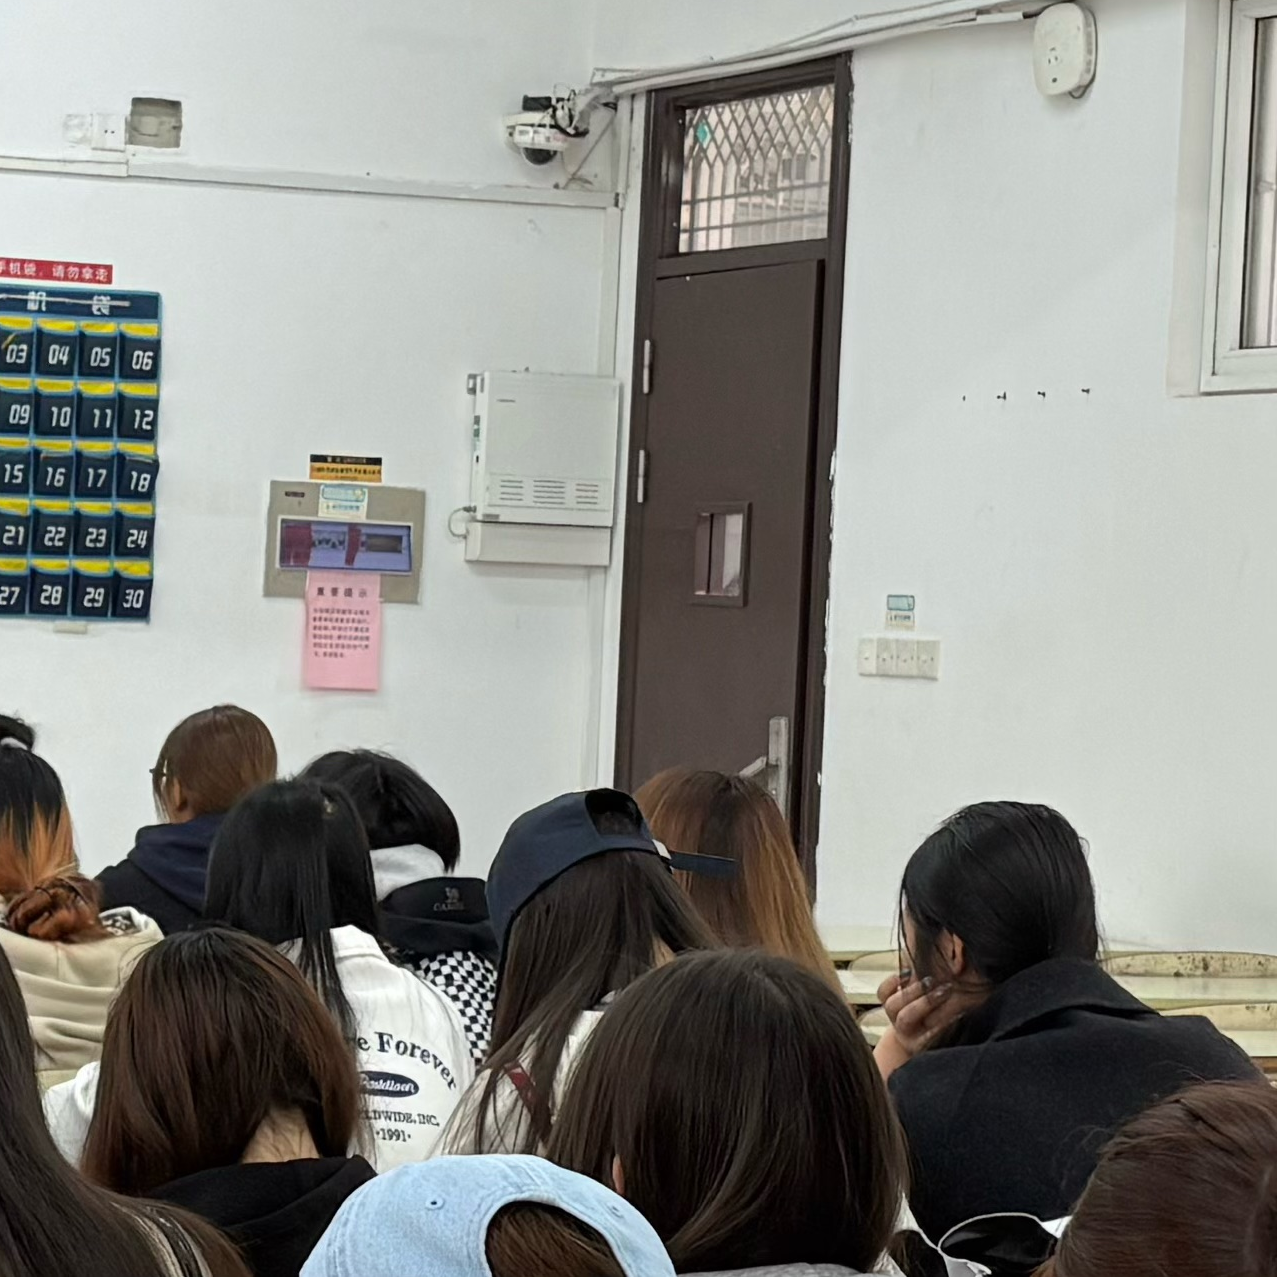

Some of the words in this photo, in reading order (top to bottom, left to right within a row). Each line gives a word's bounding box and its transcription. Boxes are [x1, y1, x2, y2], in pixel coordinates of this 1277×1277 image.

[5, 343, 28, 364] 03
[48, 344, 70, 365] 04
[90, 346, 112, 367] 05
[131, 350, 154, 371] 06
[9, 404, 31, 425] 09
[51, 406, 72, 427] 10
[93, 408, 112, 428] 11
[134, 409, 154, 430] 12
[4, 463, 24, 484] 15
[46, 466, 66, 487] 16
[87, 467, 107, 488] 17
[130, 470, 151, 492] 18
[2, 525, 25, 546] 21
[43, 526, 67, 547] 22
[85, 527, 107, 548] 23
[126, 529, 148, 548] 24
[40, 584, 63, 606] 28
[83, 587, 105, 608] 29
[122, 589, 145, 609] 30
[374, 1031, 457, 1091] Forever
